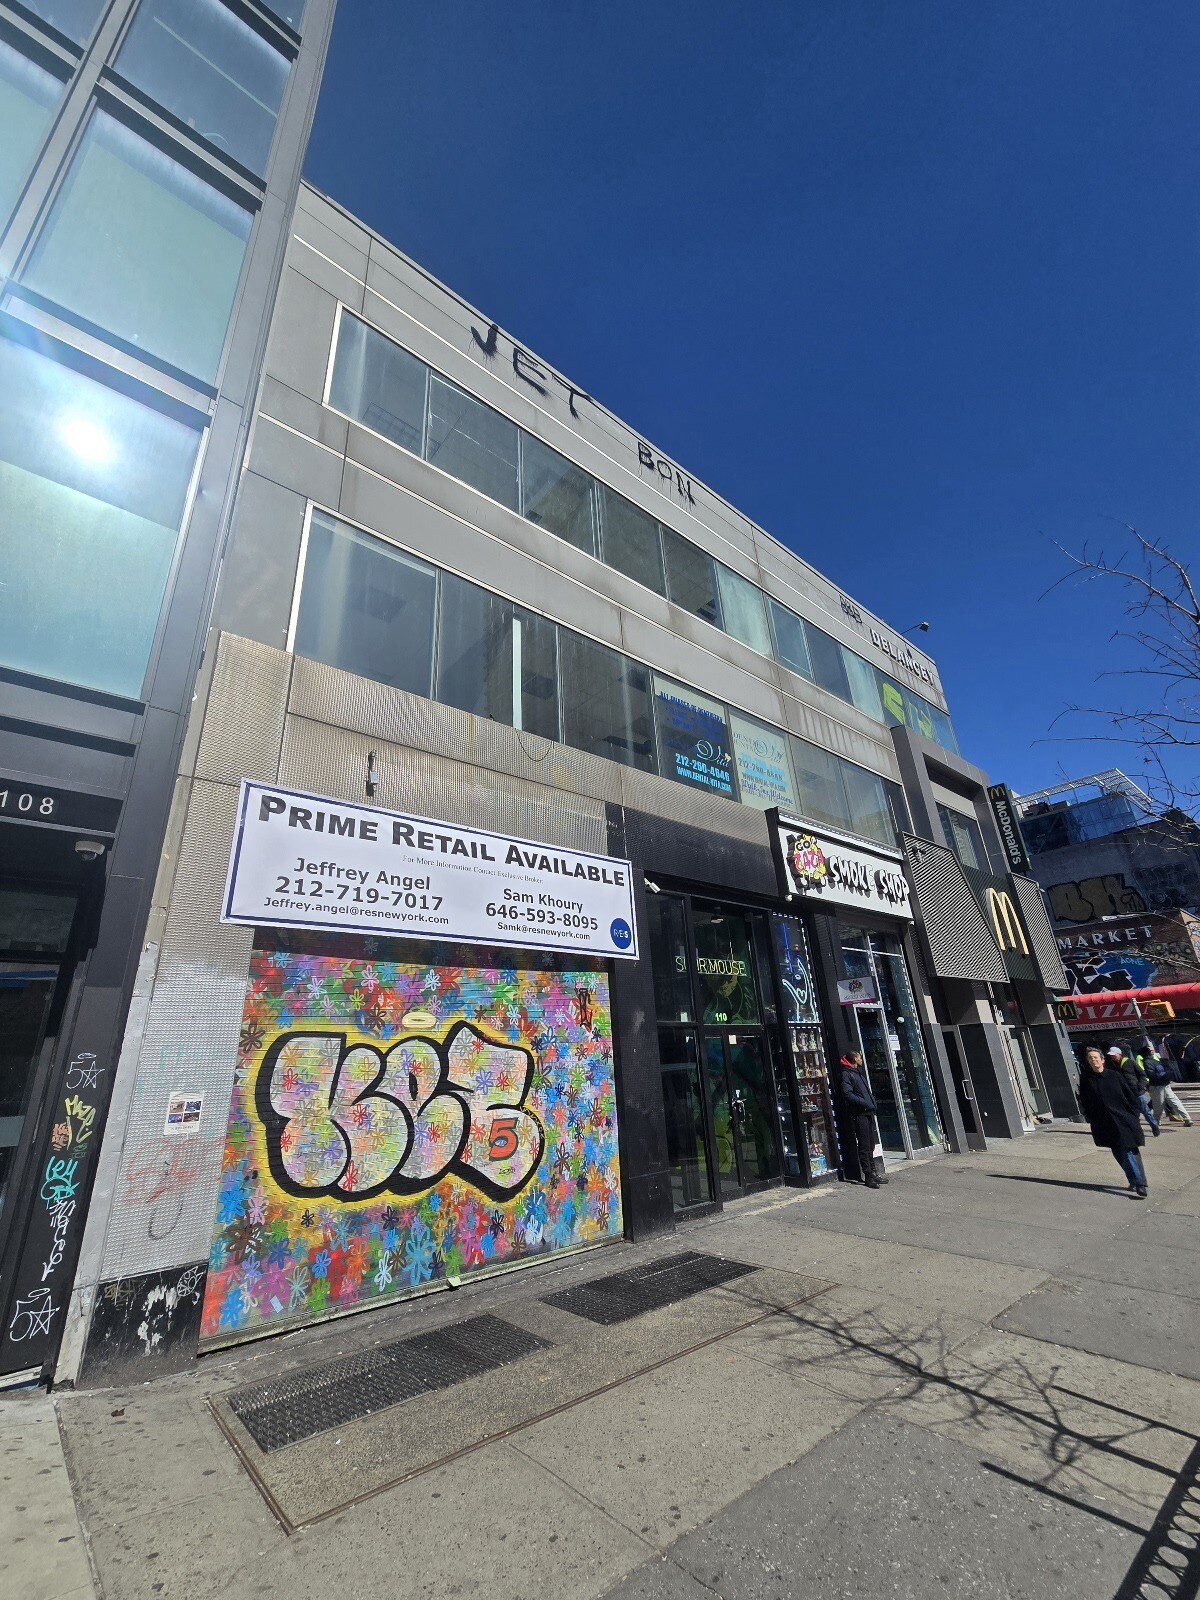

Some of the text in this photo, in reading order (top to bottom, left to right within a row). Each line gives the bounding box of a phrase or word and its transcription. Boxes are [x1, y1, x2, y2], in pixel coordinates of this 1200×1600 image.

[870, 628, 935, 686] DELANCEY
[0, 790, 54, 815] 108
[258, 794, 625, 887] PRIME RETAIL AVAILABLE
[995, 801, 1021, 865] McDonald's
[293, 857, 431, 891] Jeffrey Angel
[830, 855, 909, 903] SMOKE SHOP
[275, 876, 443, 911] 212-719-7017
[503, 888, 583, 914] Sam Khoury
[263, 897, 449, 925] Jeffrey.angel@resnewyork.com
[485, 902, 599, 931] 646-593-8095
[497, 921, 591, 940] Samk@resnewyork.com
[1057, 925, 1152, 950] MARKET
[715, 1012, 727, 1022] 110
